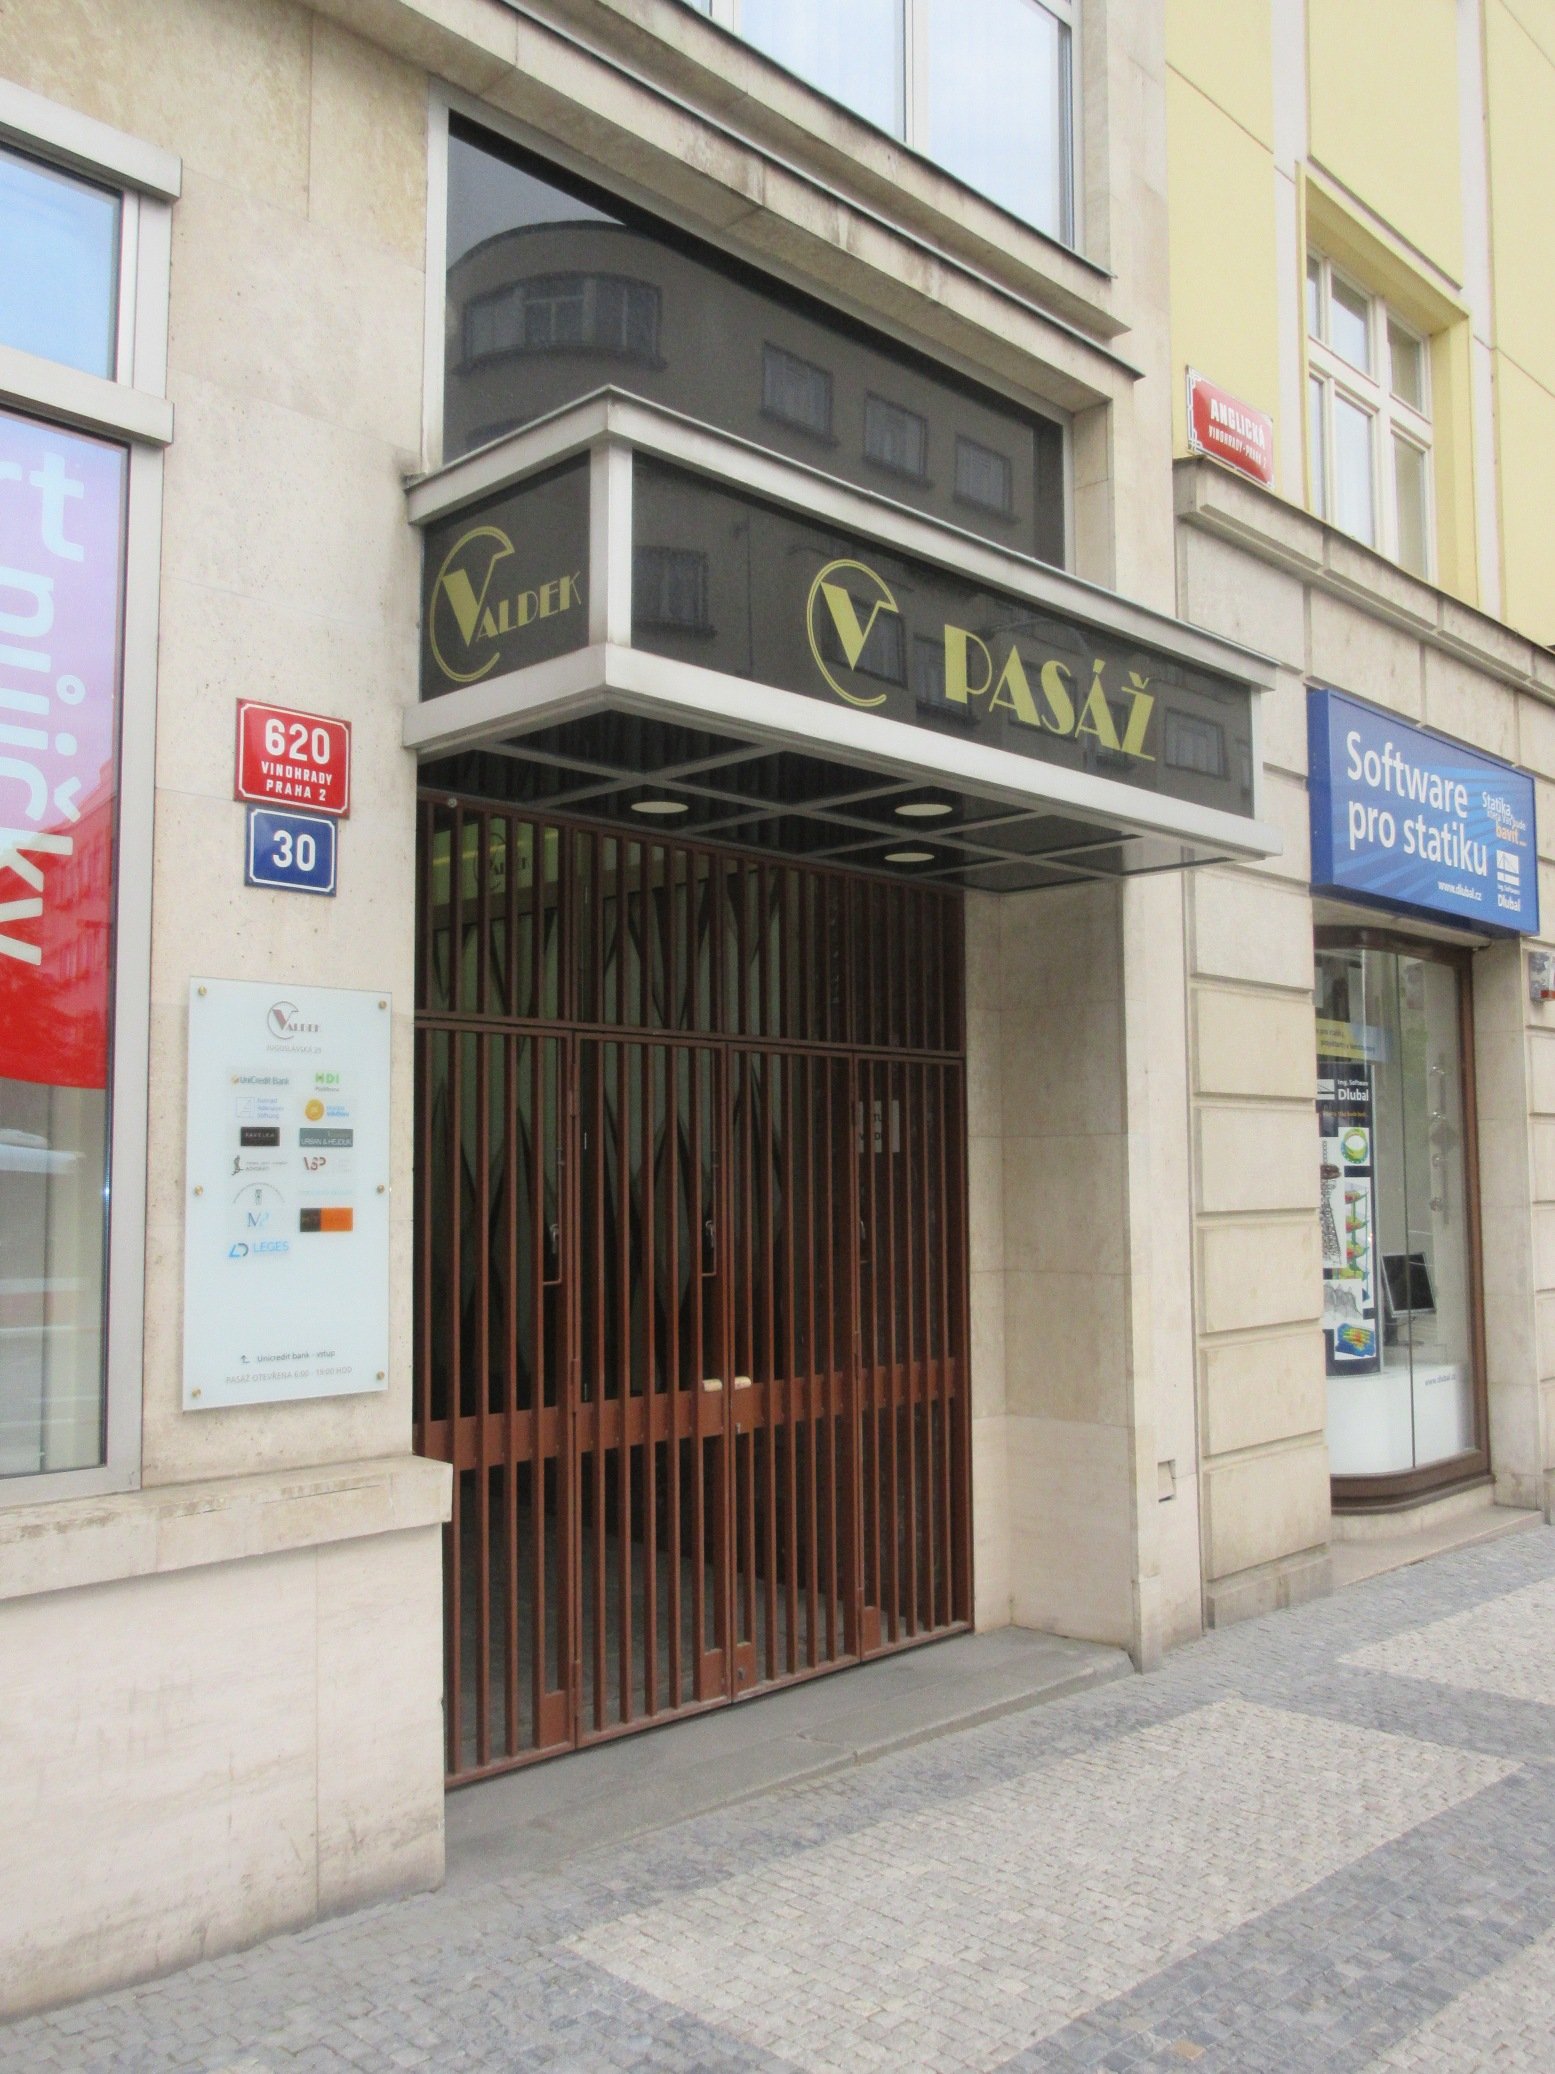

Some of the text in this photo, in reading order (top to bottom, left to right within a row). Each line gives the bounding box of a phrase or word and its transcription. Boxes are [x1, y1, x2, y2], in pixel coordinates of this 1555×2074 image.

[435, 540, 582, 665] VALDEK
[944, 623, 1156, 761] PASÁŽ
[265, 718, 330, 765] 620
[261, 760, 333, 786] VINOHRADY
[1347, 730, 1468, 818] Software
[266, 780, 327, 802] PRAHA 2
[272, 829, 316, 872] 30
[1349, 800, 1488, 877] pro statiku
[1437, 881, 1483, 902] www.dlubal.cz
[1497, 893, 1521, 913] Dlubal
[315, 1072, 340, 1084] HDI
[1337, 1088, 1369, 1101] Dlubal
[253, 1240, 289, 1252] LEGES
[257, 1353, 290, 1363] Unicredit
